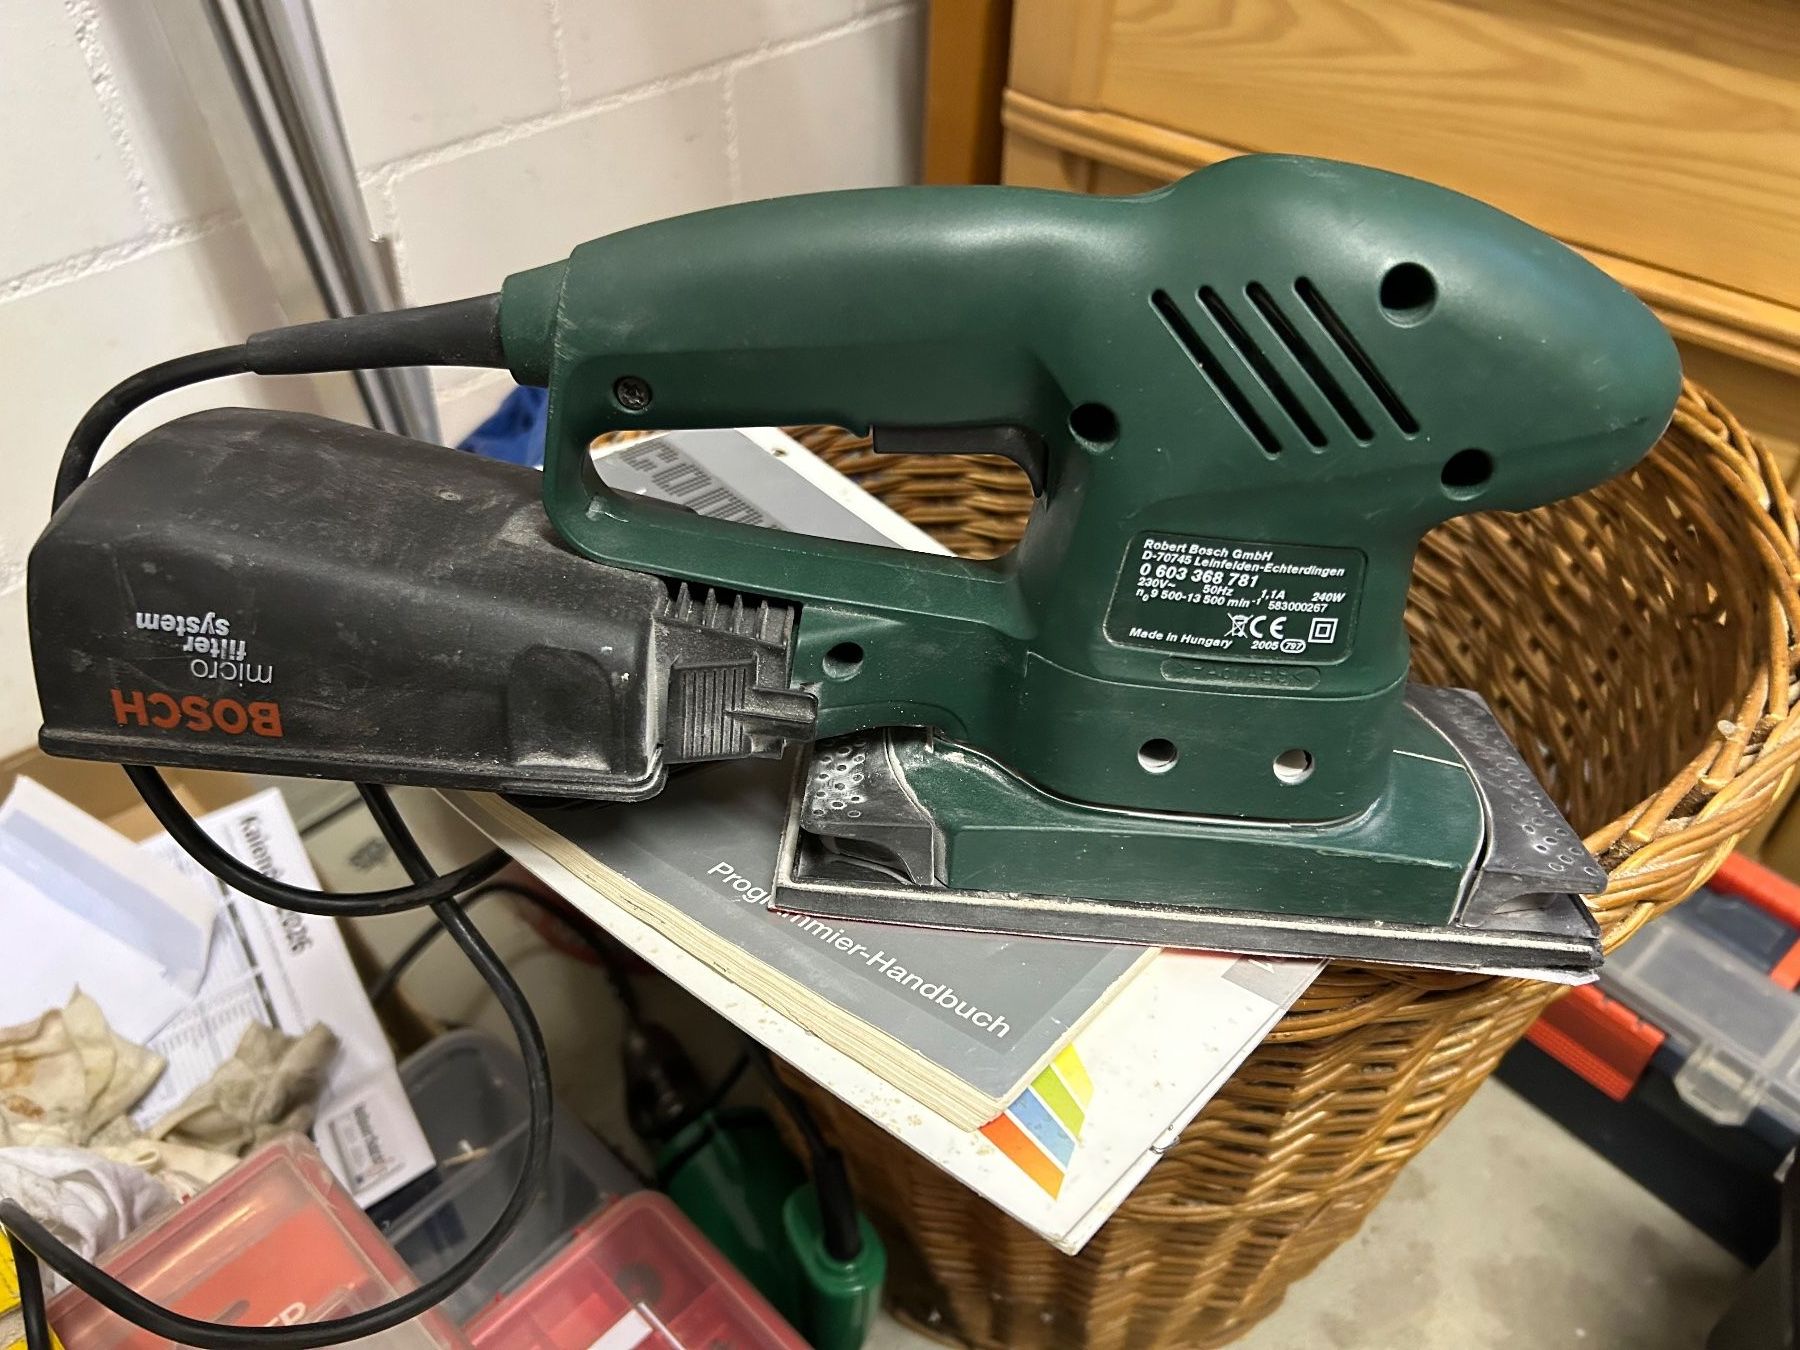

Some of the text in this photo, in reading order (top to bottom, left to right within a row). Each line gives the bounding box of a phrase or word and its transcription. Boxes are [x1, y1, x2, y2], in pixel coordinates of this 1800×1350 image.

[1143, 539, 1273, 561] Robert Bosch GmbH
[1139, 563, 1259, 588] 0 603 368 781
[1141, 550, 1345, 577] D-70745 Leinfelden-Echterdingen
[1160, 590, 1201, 604] 500-13
[1202, 594, 1226, 606] 500
[1267, 600, 1329, 614] 583000267
[1202, 584, 1234, 597] 50Hz
[1311, 592, 1346, 603] 240W
[136, 611, 231, 637] system
[183, 635, 247, 661] filter
[1128, 627, 1234, 650] Made in Hungary
[1250, 640, 1305, 651] 2005 797
[190, 658, 273, 687] micro
[110, 688, 284, 738] BOSCH
